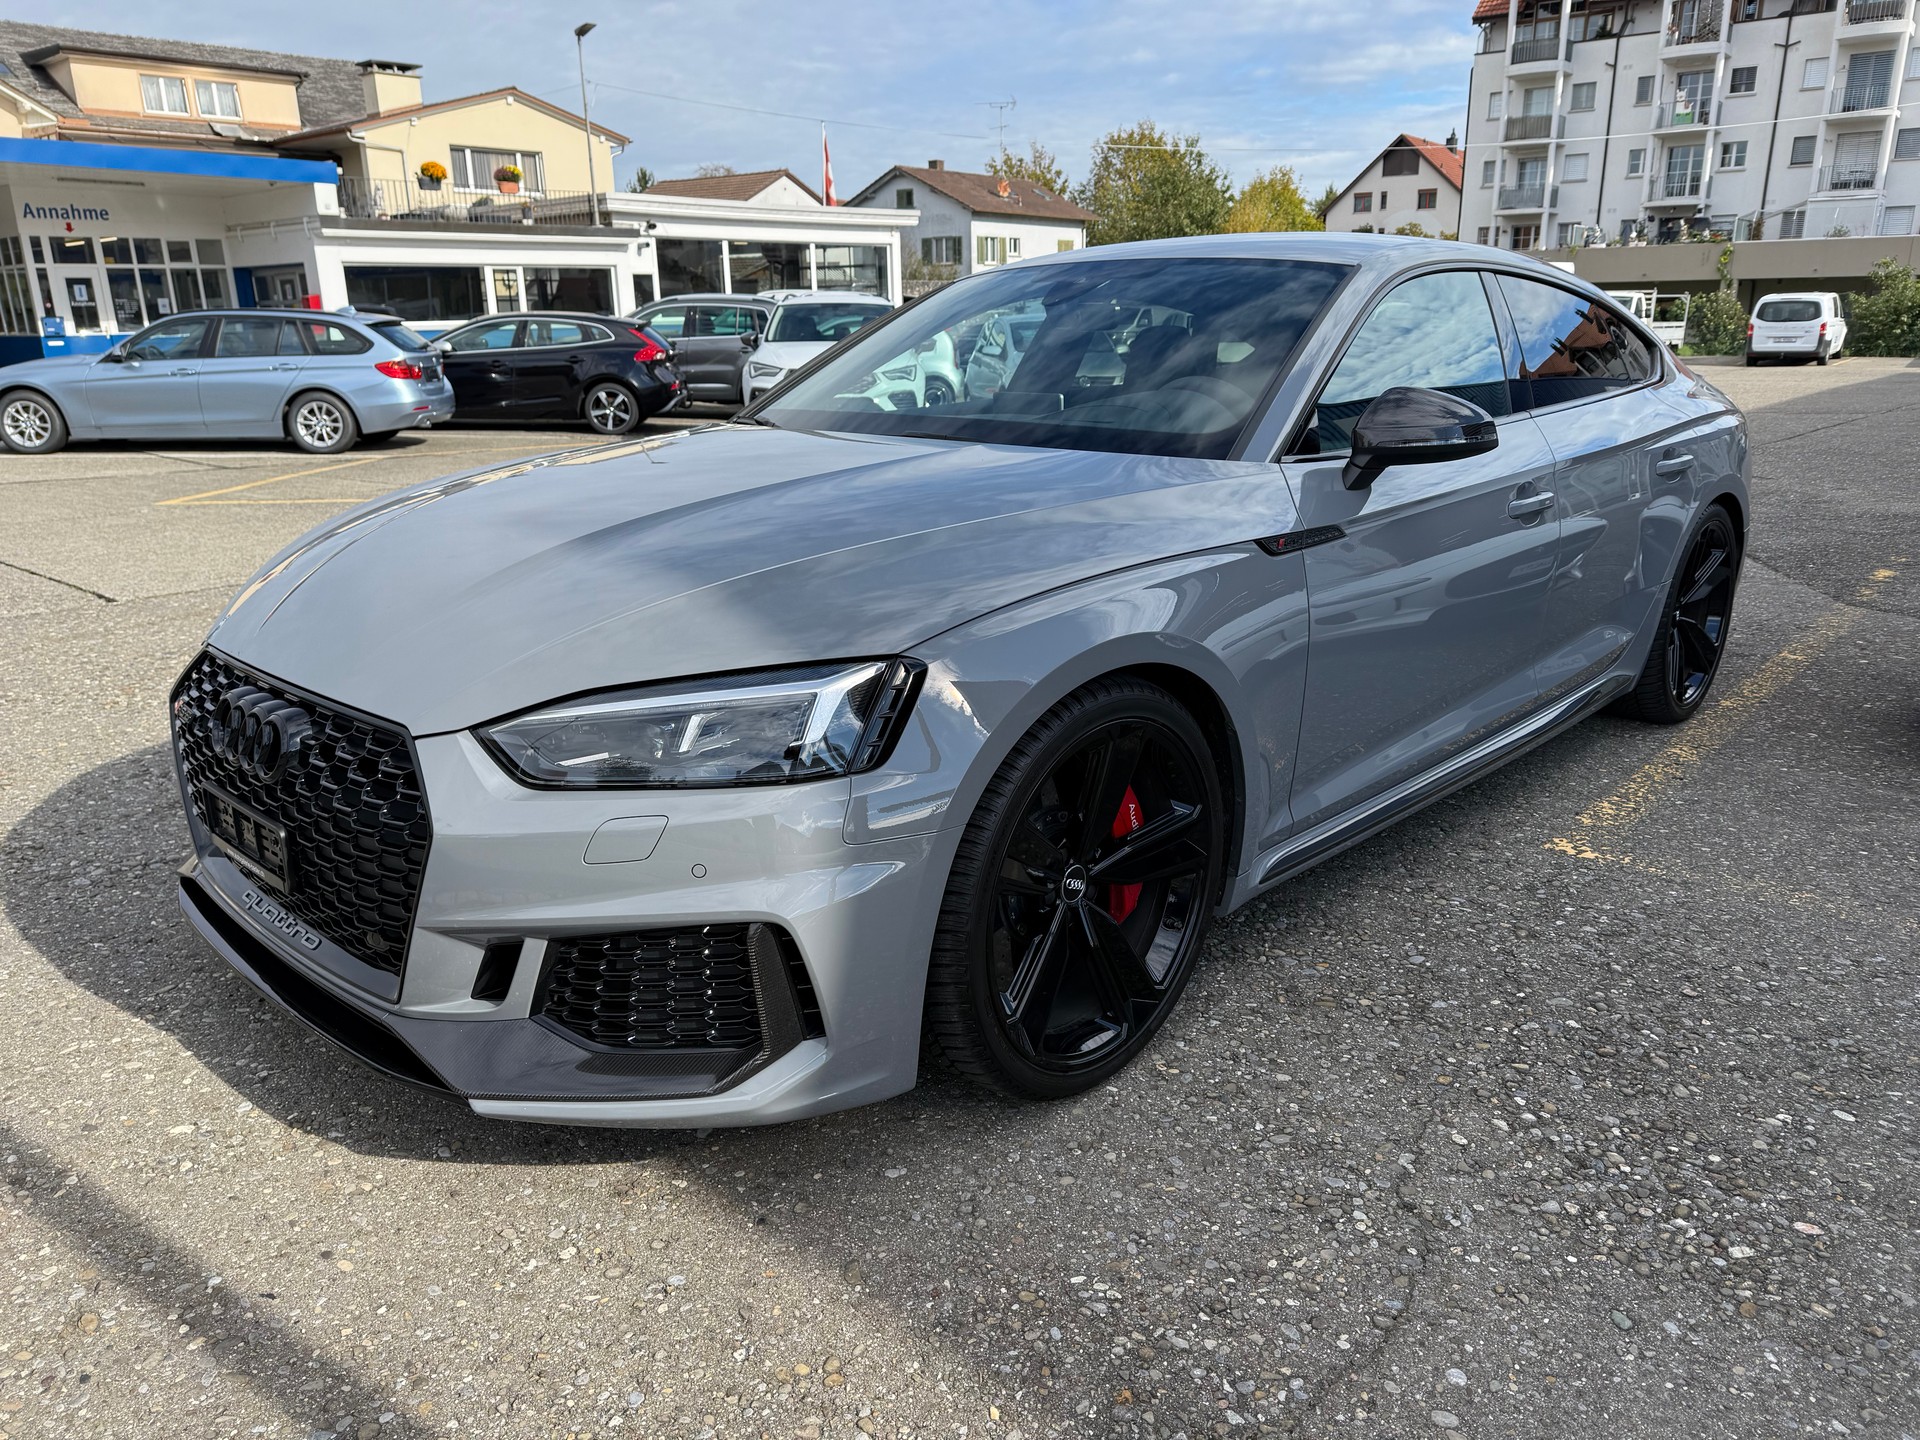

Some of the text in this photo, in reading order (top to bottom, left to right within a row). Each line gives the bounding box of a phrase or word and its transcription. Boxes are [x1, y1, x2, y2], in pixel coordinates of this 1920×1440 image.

[23, 203, 109, 221] Annahme
[1129, 804, 1140, 830] Audi
[242, 889, 321, 950] quattro
